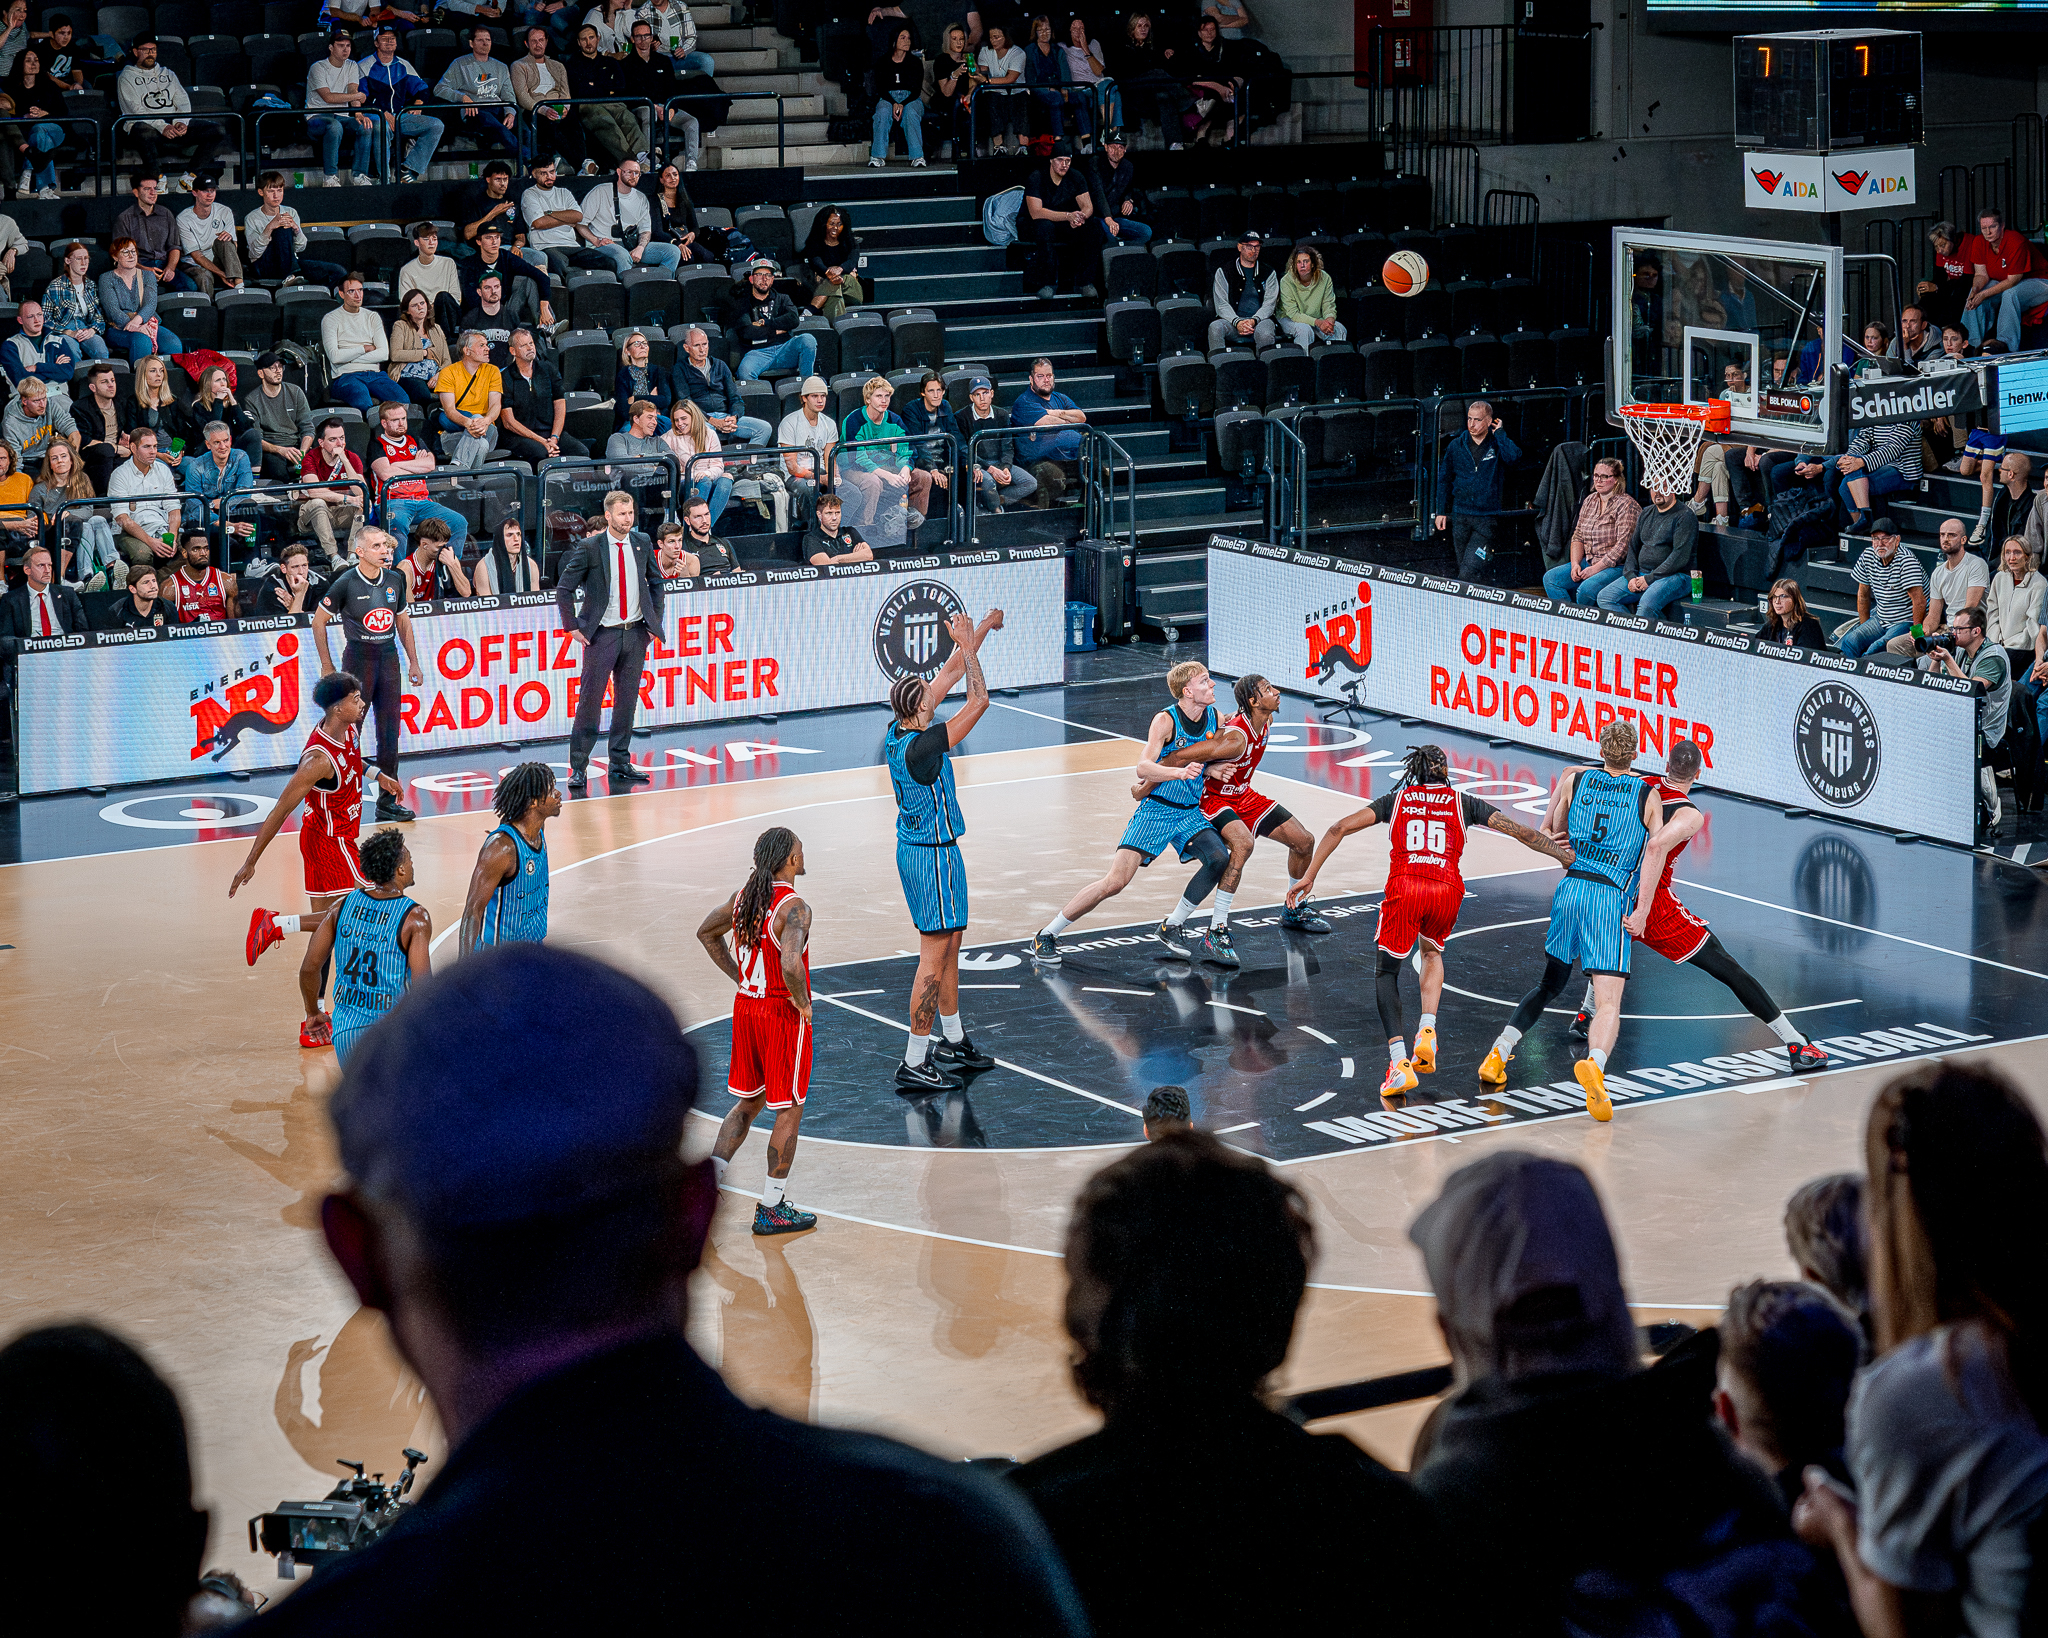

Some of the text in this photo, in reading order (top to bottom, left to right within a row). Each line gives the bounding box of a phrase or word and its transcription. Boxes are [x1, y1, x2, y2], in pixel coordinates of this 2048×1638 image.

[1782, 181, 1818, 198] AIDA
[1868, 176, 1908, 195] AIDA
[1769, 396, 1800, 408] BBL POKAL
[1851, 386, 1956, 420] Schindler
[2008, 391, 2048, 406] henw.
[24, 634, 86, 651] PrimeLED
[96, 628, 157, 645] PrimeLED
[167, 621, 228, 638] PrimeLED
[238, 614, 297, 632] PrimeLED
[406, 602, 433, 616] eLED
[443, 596, 500, 612] PrimeLED
[510, 591, 557, 606] PrimeLE
[704, 572, 757, 588] PrimeLED
[766, 567, 819, 582] PrimeLED
[828, 561, 880, 576] PrimeLED
[889, 556, 940, 571] PrimeLED
[949, 550, 1000, 566] PrimeLED
[1009, 545, 1059, 560] PrimeLED
[879, 586, 961, 637] VEOLIA TOWE
[1305, 597, 1357, 624] ENERGY
[1211, 535, 1971, 694] PrimeLED PrimeLED PrimeLED PrimeLED PrimeLED PrimeLED PrimeLED PrimeLED PrimeLED PrimeLED PrimeLED PrimeLED PrimeLED PrimeLED PrimeLED PrimeLED
[437, 613, 735, 680] OFFIZLER
[190, 653, 274, 701] ENERGY
[895, 662, 946, 681] HABUR
[1461, 623, 1678, 708] OFFIZIELLER
[399, 681, 551, 736] RADIO
[1430, 665, 1714, 769] RADIO PARTNER
[1799, 689, 1875, 749] VEOLIA TOWERS
[1403, 791, 1454, 805] CROWLEY
[1812, 772, 1861, 799] HAMBURG
[1595, 798, 1630, 809] VEOLIA
[1406, 819, 1446, 855] 85
[1591, 812, 1610, 843] 5
[1408, 853, 1446, 868] Bamberg
[1571, 838, 1619, 866] AMBURG
[351, 905, 378, 924] REED
[354, 928, 388, 943] VEOLIA
[343, 947, 378, 988] 43
[333, 984, 393, 1011] HAMBURG
[1302, 1022, 1994, 1144] MORE THAN BASKTBALL
